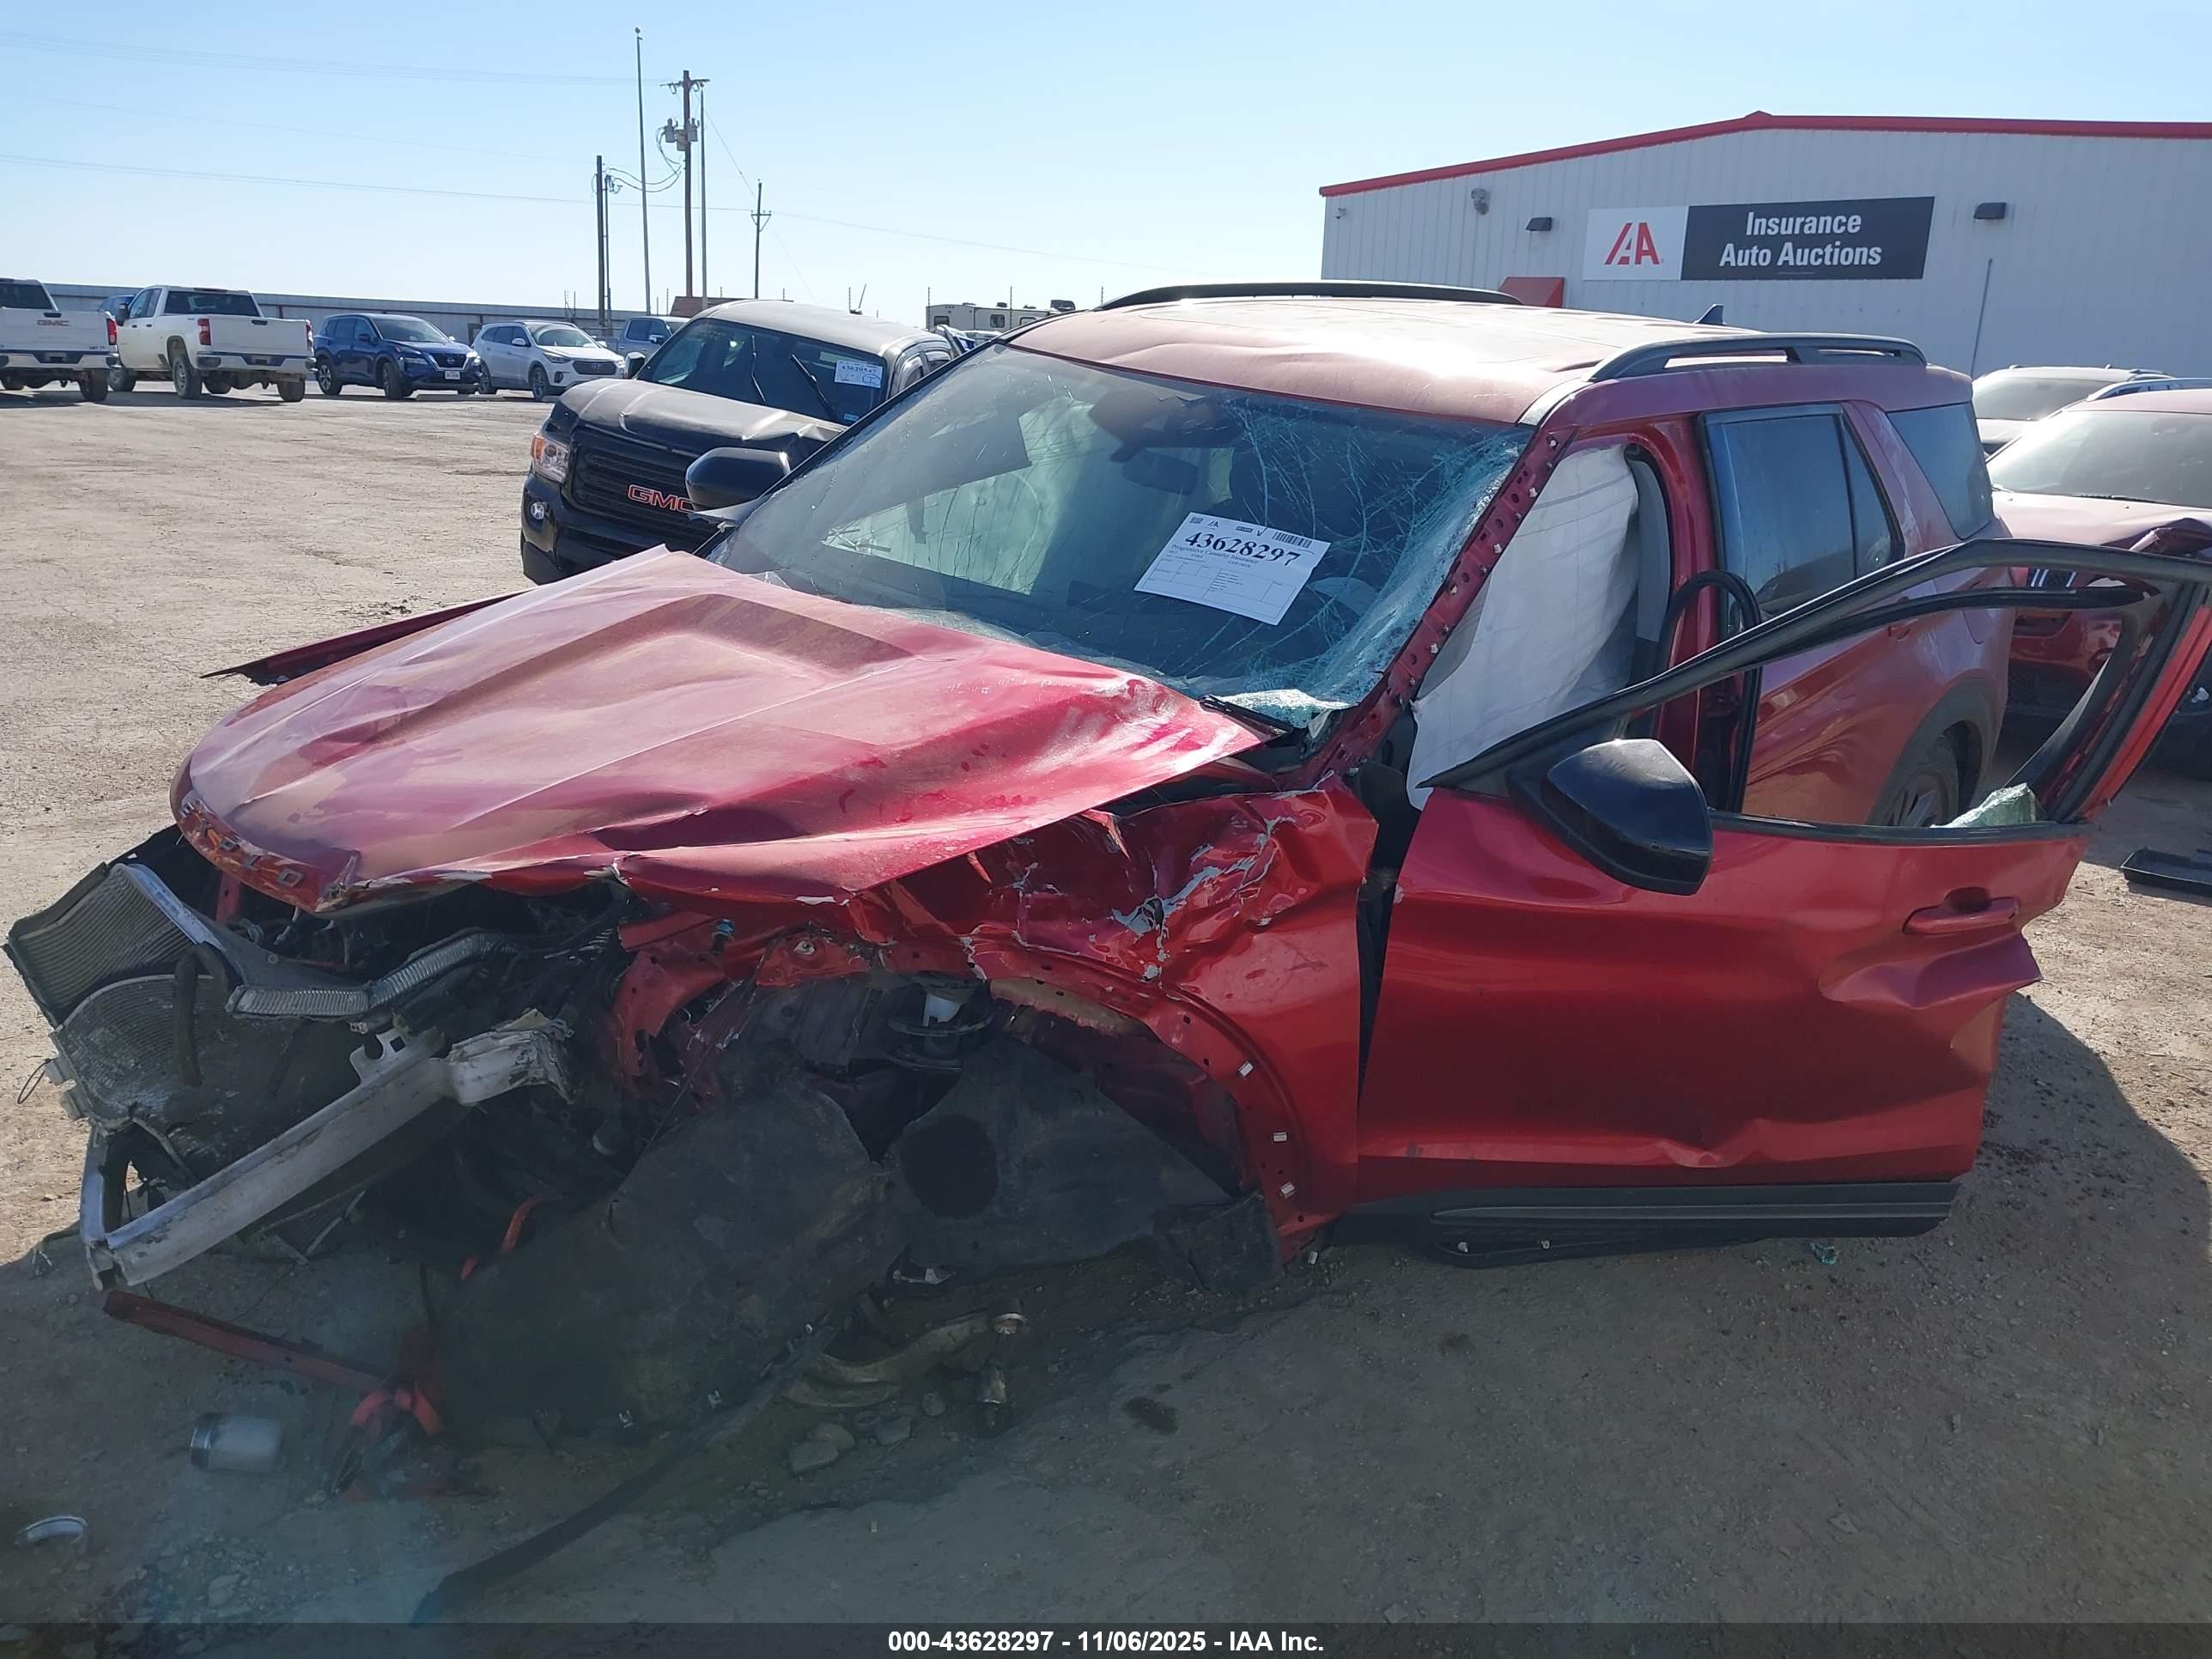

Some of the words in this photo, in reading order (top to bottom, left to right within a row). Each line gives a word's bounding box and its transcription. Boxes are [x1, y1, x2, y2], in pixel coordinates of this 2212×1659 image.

[1745, 211, 1862, 237] Insurance
[1719, 242, 1771, 267] Auto
[1776, 240, 1882, 267] Auctions
[37, 319, 70, 327] GMC
[628, 484, 696, 514] GMC
[1185, 532, 1302, 567] 43628297
